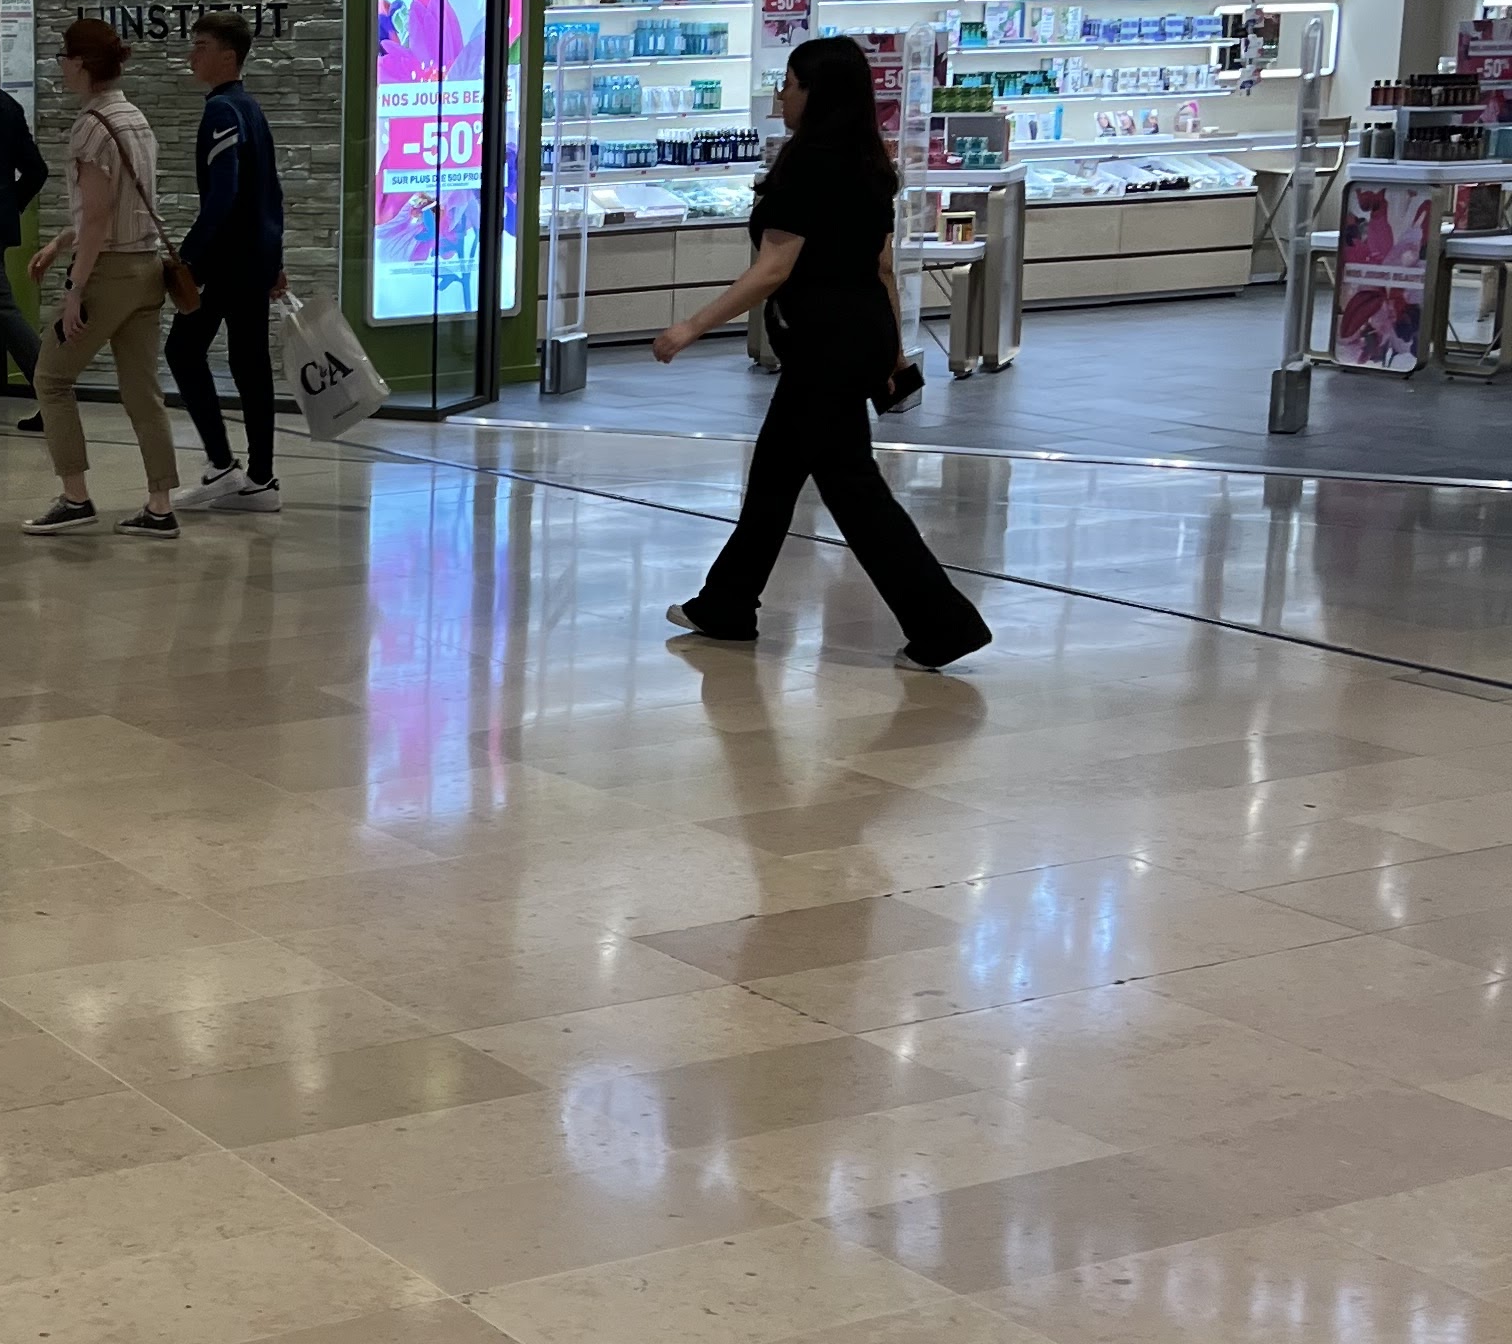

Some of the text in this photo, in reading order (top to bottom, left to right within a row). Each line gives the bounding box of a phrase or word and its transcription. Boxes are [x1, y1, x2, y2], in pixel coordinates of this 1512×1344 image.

[381, 92, 409, 108] NOS
[411, 90, 459, 107] JOURS
[409, 174, 431, 184] PLUS
[299, 351, 355, 396] C&A
